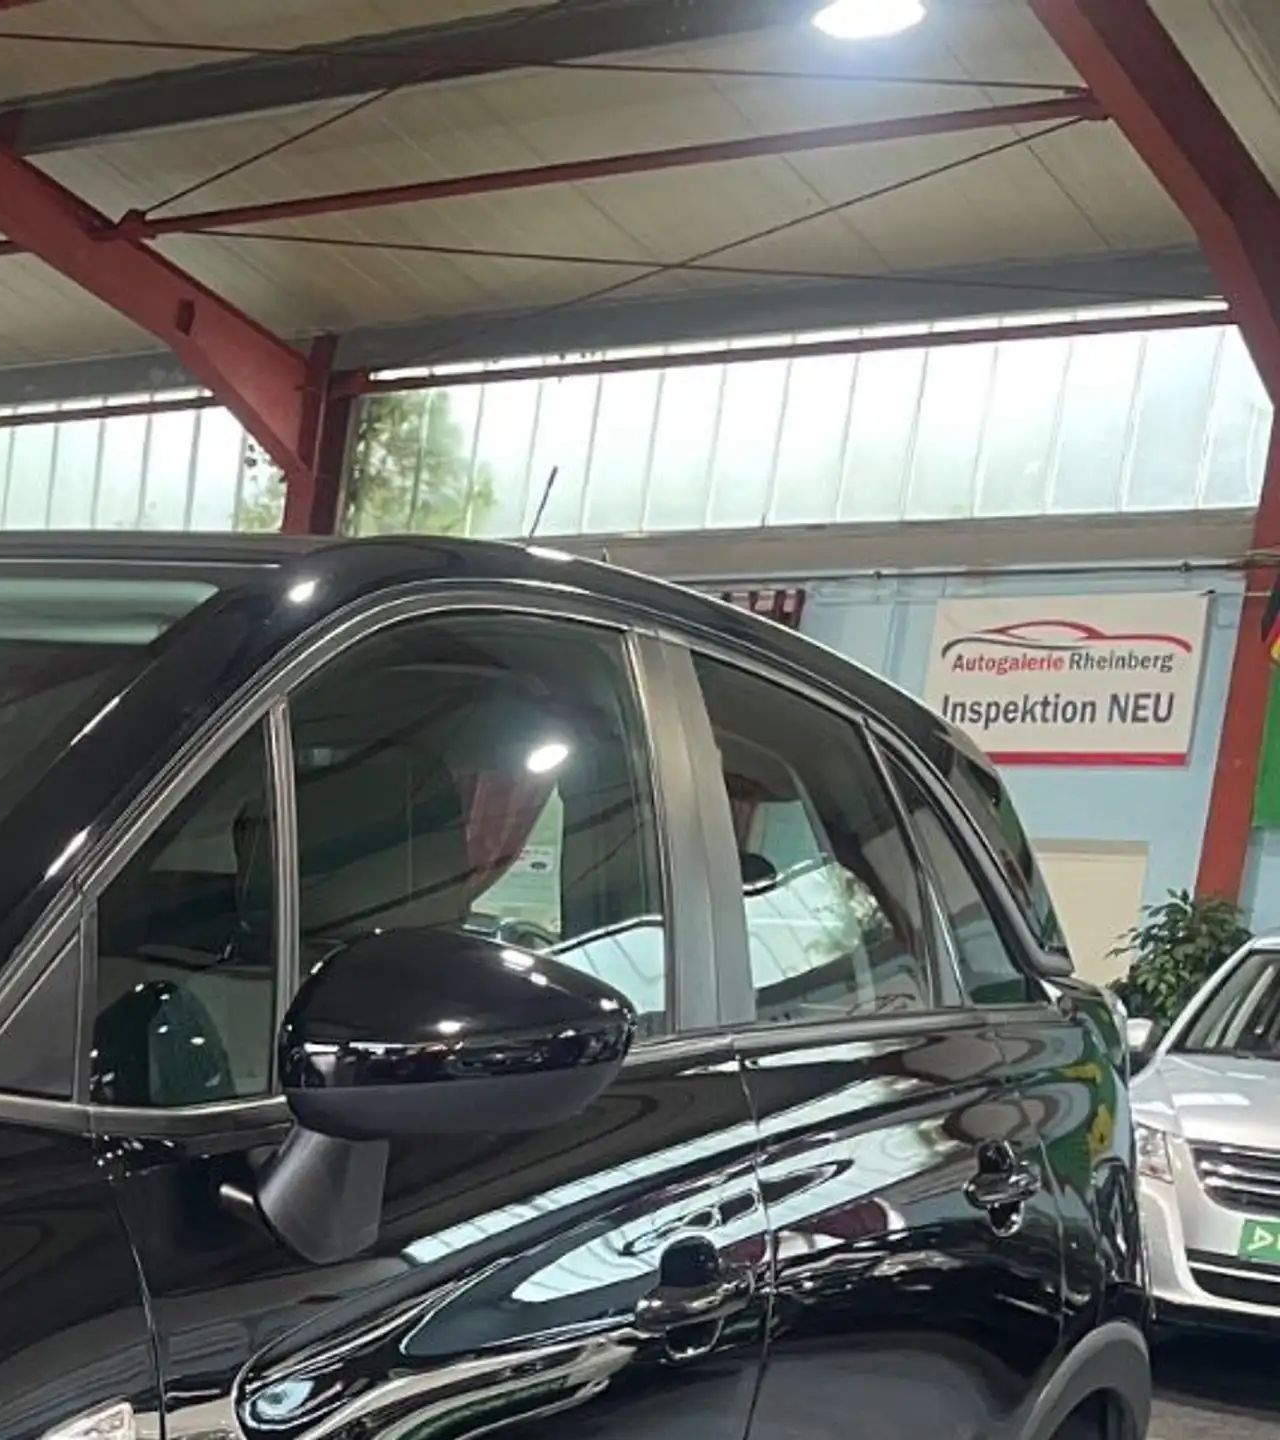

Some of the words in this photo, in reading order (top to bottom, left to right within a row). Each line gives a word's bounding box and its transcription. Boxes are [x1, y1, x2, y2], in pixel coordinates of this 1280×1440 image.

[952, 652, 1065, 676] Autogalerie
[1068, 649, 1175, 673] Rheinberg
[942, 693, 1097, 730] Inspektion
[1107, 691, 1175, 724] NEU
